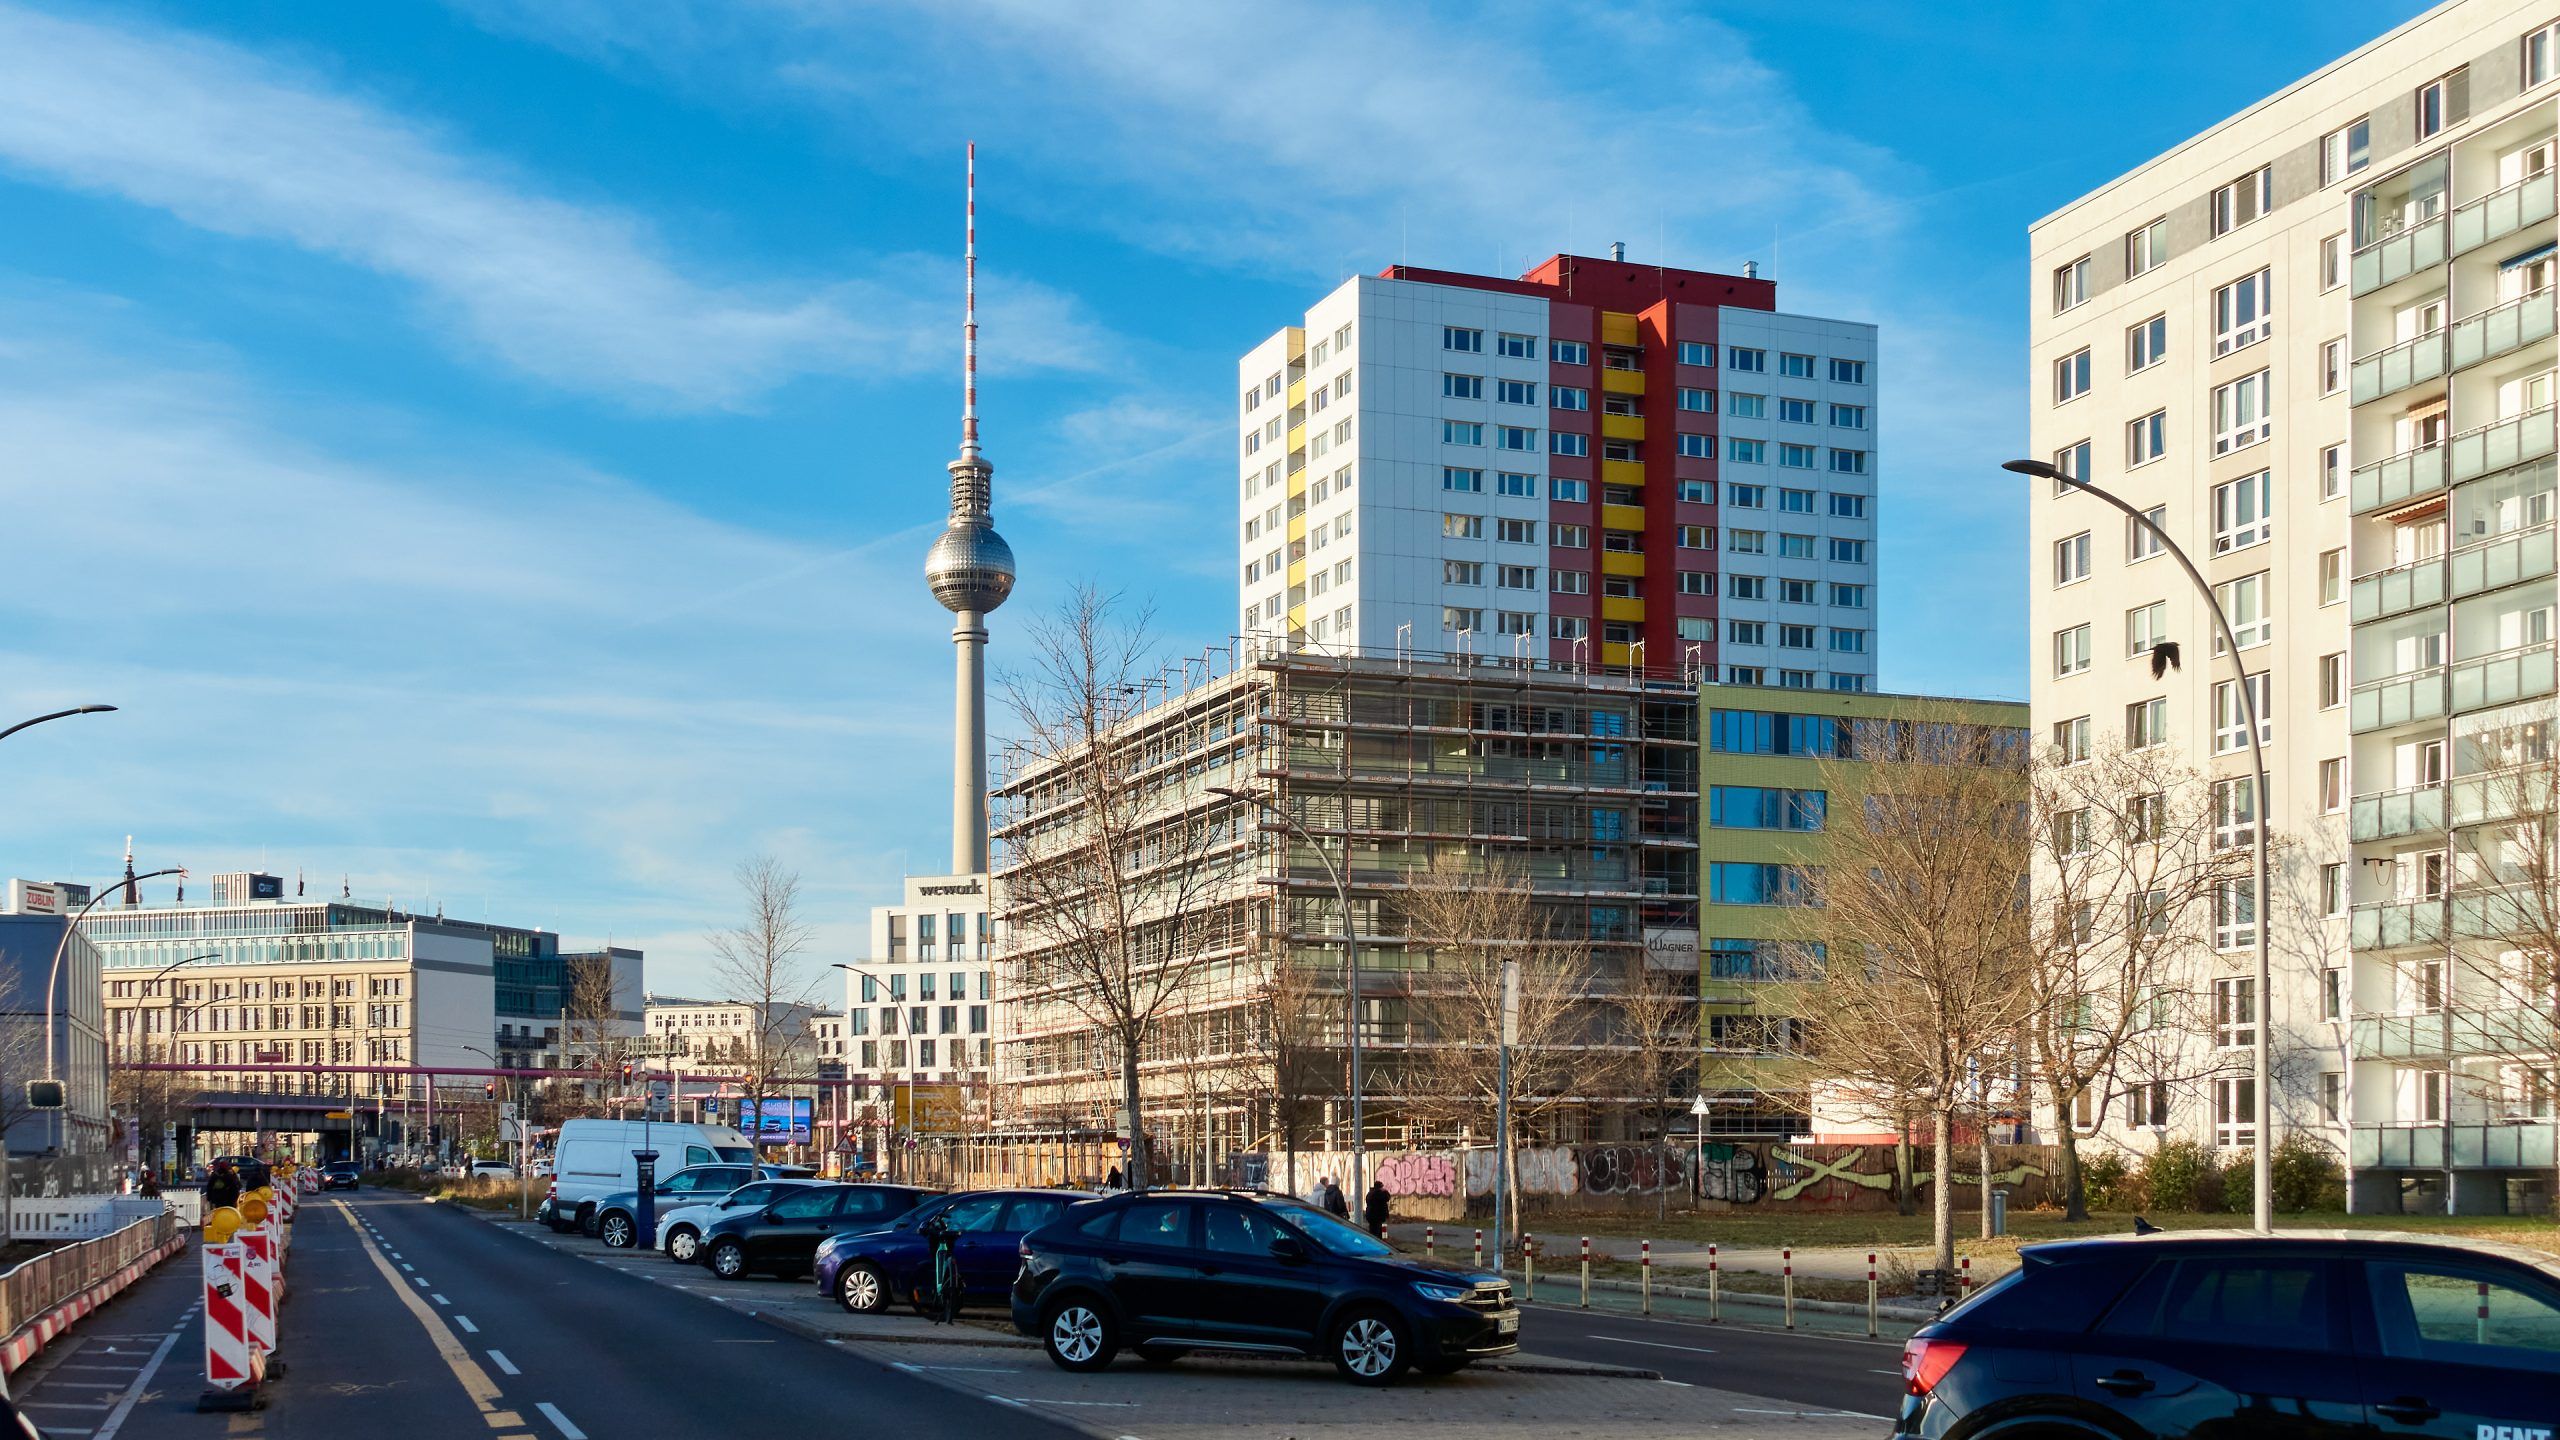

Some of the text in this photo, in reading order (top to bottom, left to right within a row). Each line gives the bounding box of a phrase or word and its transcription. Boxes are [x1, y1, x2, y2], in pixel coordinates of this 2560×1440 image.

[918, 879, 983, 896] wework
[1649, 937, 1694, 952] WAGNER
[2476, 1424, 2551, 1440] RENT
